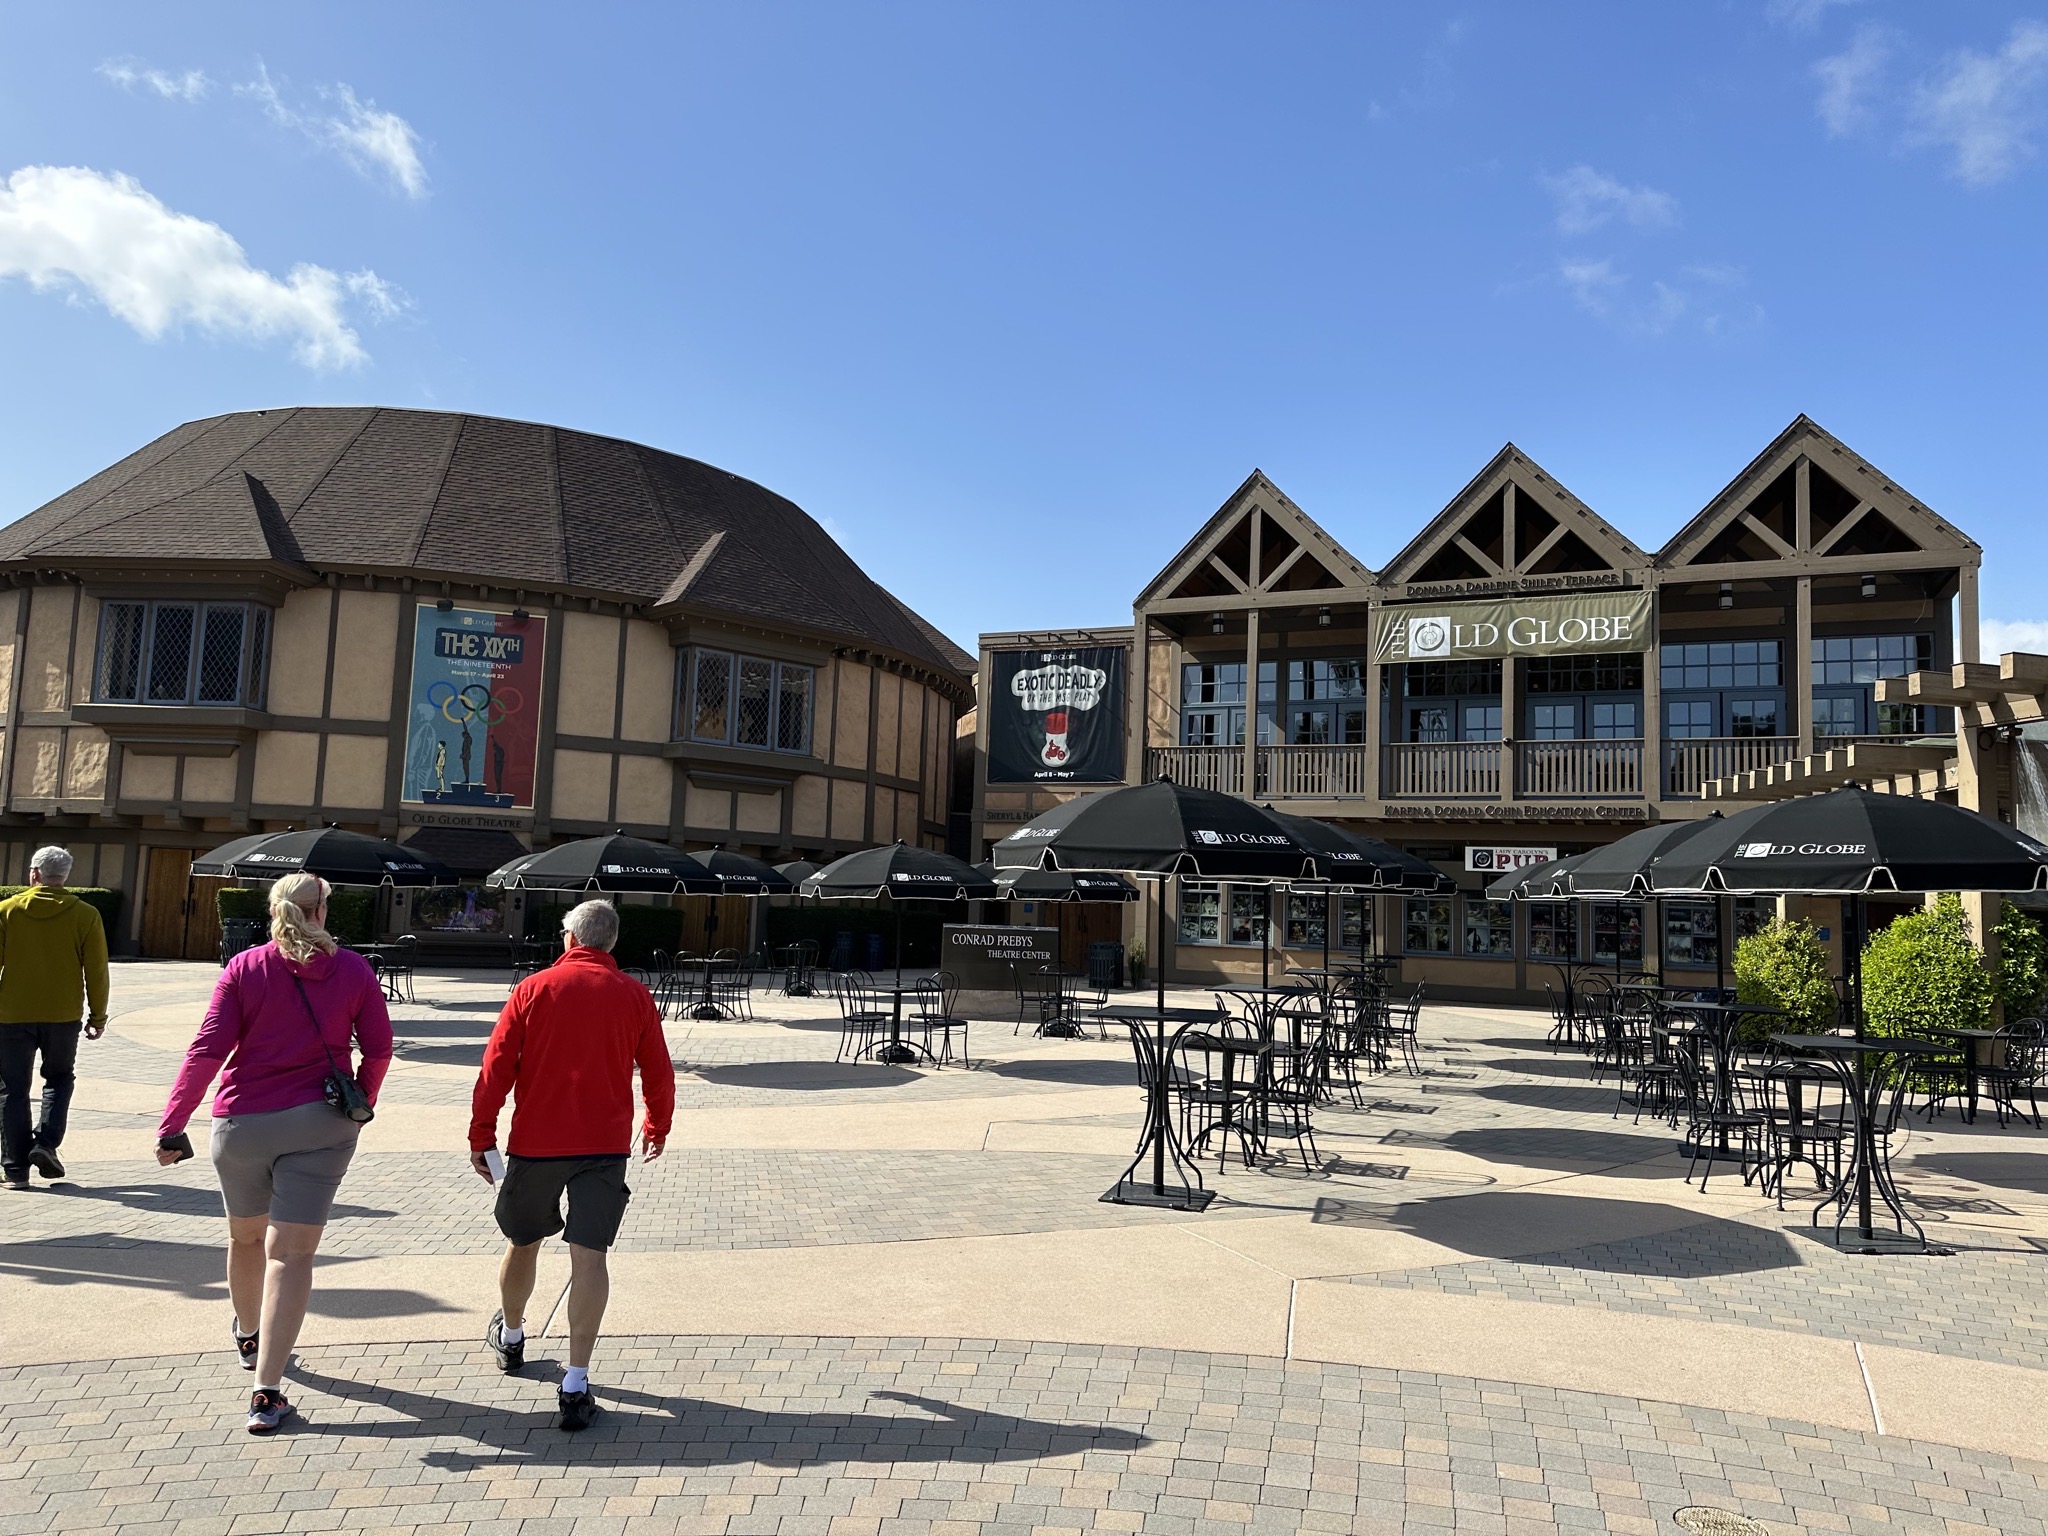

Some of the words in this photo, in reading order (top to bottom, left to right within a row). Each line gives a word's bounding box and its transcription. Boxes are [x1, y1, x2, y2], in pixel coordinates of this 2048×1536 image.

[1406, 585, 1452, 595] DONALD
[1454, 584, 1462, 592] &
[1466, 580, 1518, 592] DARLENE
[1520, 577, 1561, 589] SHILEY
[1563, 574, 1618, 586] TERRACE
[1391, 620, 1405, 659] THE
[1507, 616, 1633, 647] GLOBE
[441, 632, 480, 657] THE
[463, 660, 512, 670] NINETEENTH
[1017, 673, 1055, 691] EXOTIC
[1040, 693, 1051, 703] THE
[1074, 692, 1091, 703] PLAY
[435, 792, 441, 800] 2
[494, 795, 500, 803] 3
[987, 811, 1016, 820] SHERYL
[1016, 812, 1022, 820] &
[1384, 805, 1421, 816] KAREN
[1423, 806, 1430, 815] &
[1435, 805, 1481, 816] DONALD
[1485, 805, 1520, 816] COHN
[1524, 805, 1591, 816] EDUCATION
[1595, 805, 1642, 816] CENTER
[412, 813, 435, 824] OLD
[438, 815, 473, 826] GLOBE
[475, 817, 522, 828] THEATRE
[1239, 833, 1290, 845] GLOBE
[1734, 843, 1748, 858] THE
[1798, 843, 1866, 855] GLOBE
[274, 855, 303, 863] GLOBE
[635, 866, 671, 874] GLOBE
[921, 874, 953, 882] GLOBE
[952, 933, 994, 946] CONRAD
[997, 935, 1033, 947] PREBYS
[987, 949, 1021, 959] THEATRE
[1021, 950, 1051, 960] CENTER
